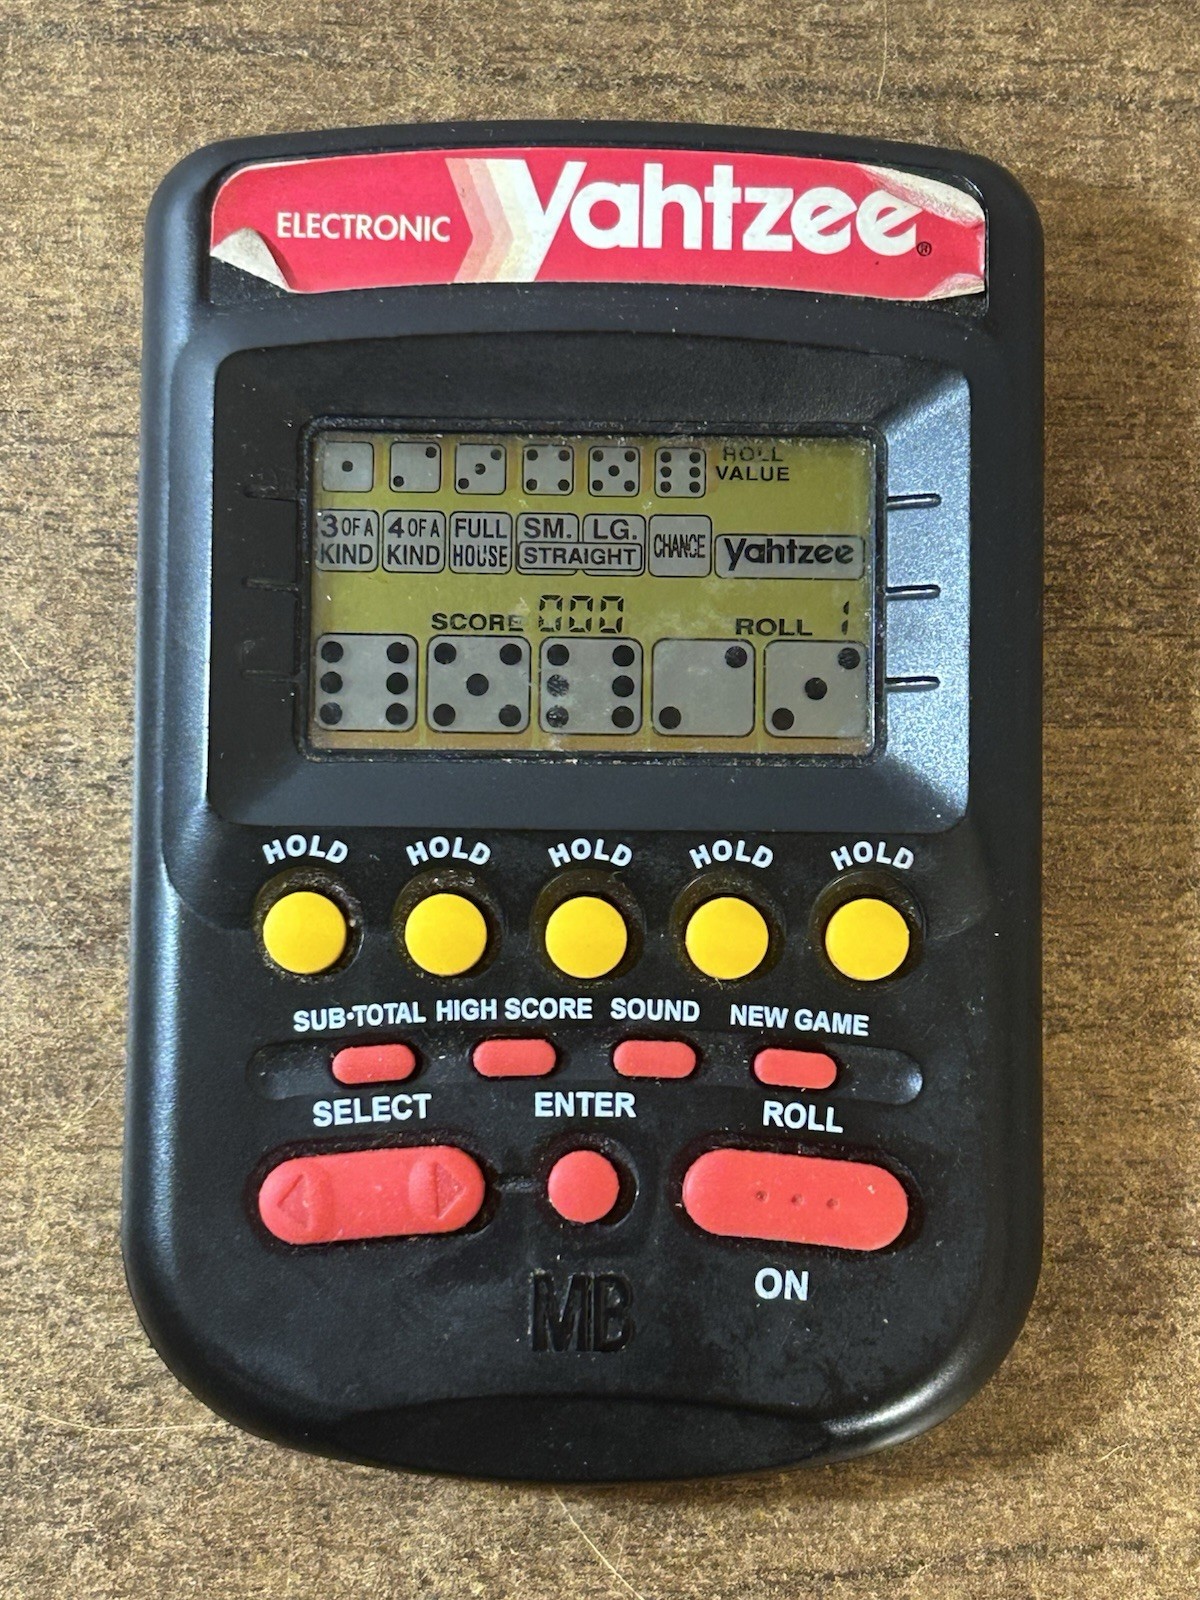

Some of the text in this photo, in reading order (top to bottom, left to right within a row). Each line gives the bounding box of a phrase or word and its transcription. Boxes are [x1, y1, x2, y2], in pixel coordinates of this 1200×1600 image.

[276, 211, 452, 244] ELECTRONIC
[716, 465, 790, 482] VALUE
[320, 514, 338, 538] 3
[341, 518, 361, 537] OF
[388, 517, 404, 538] 4
[409, 518, 427, 538] OF
[455, 518, 508, 539] FULL
[524, 518, 572, 539] SM.
[593, 518, 638, 540] LG.
[320, 543, 374, 564] KIND
[387, 545, 440, 566] KIND
[453, 545, 508, 567] HOUSE
[523, 547, 637, 566] STRAIGHT
[653, 533, 706, 559] CHANCE
[431, 612, 524, 631] SCORE
[735, 600, 850, 636] ROLL 1
[262, 834, 349, 865] HOLD
[405, 836, 491, 866] HOLD
[547, 838, 633, 867] HOLD
[689, 839, 774, 869] HOLD
[830, 841, 915, 871] HOLD
[435, 997, 593, 1022] HIGH SCORE
[610, 997, 700, 1022] SOUND
[729, 1004, 870, 1037] NEW GAME
[312, 1093, 432, 1127] SELECT
[534, 1091, 637, 1118] ENTER
[762, 1100, 844, 1134] ROLL
[754, 1267, 809, 1301] ON
[530, 1269, 636, 1352] MB
